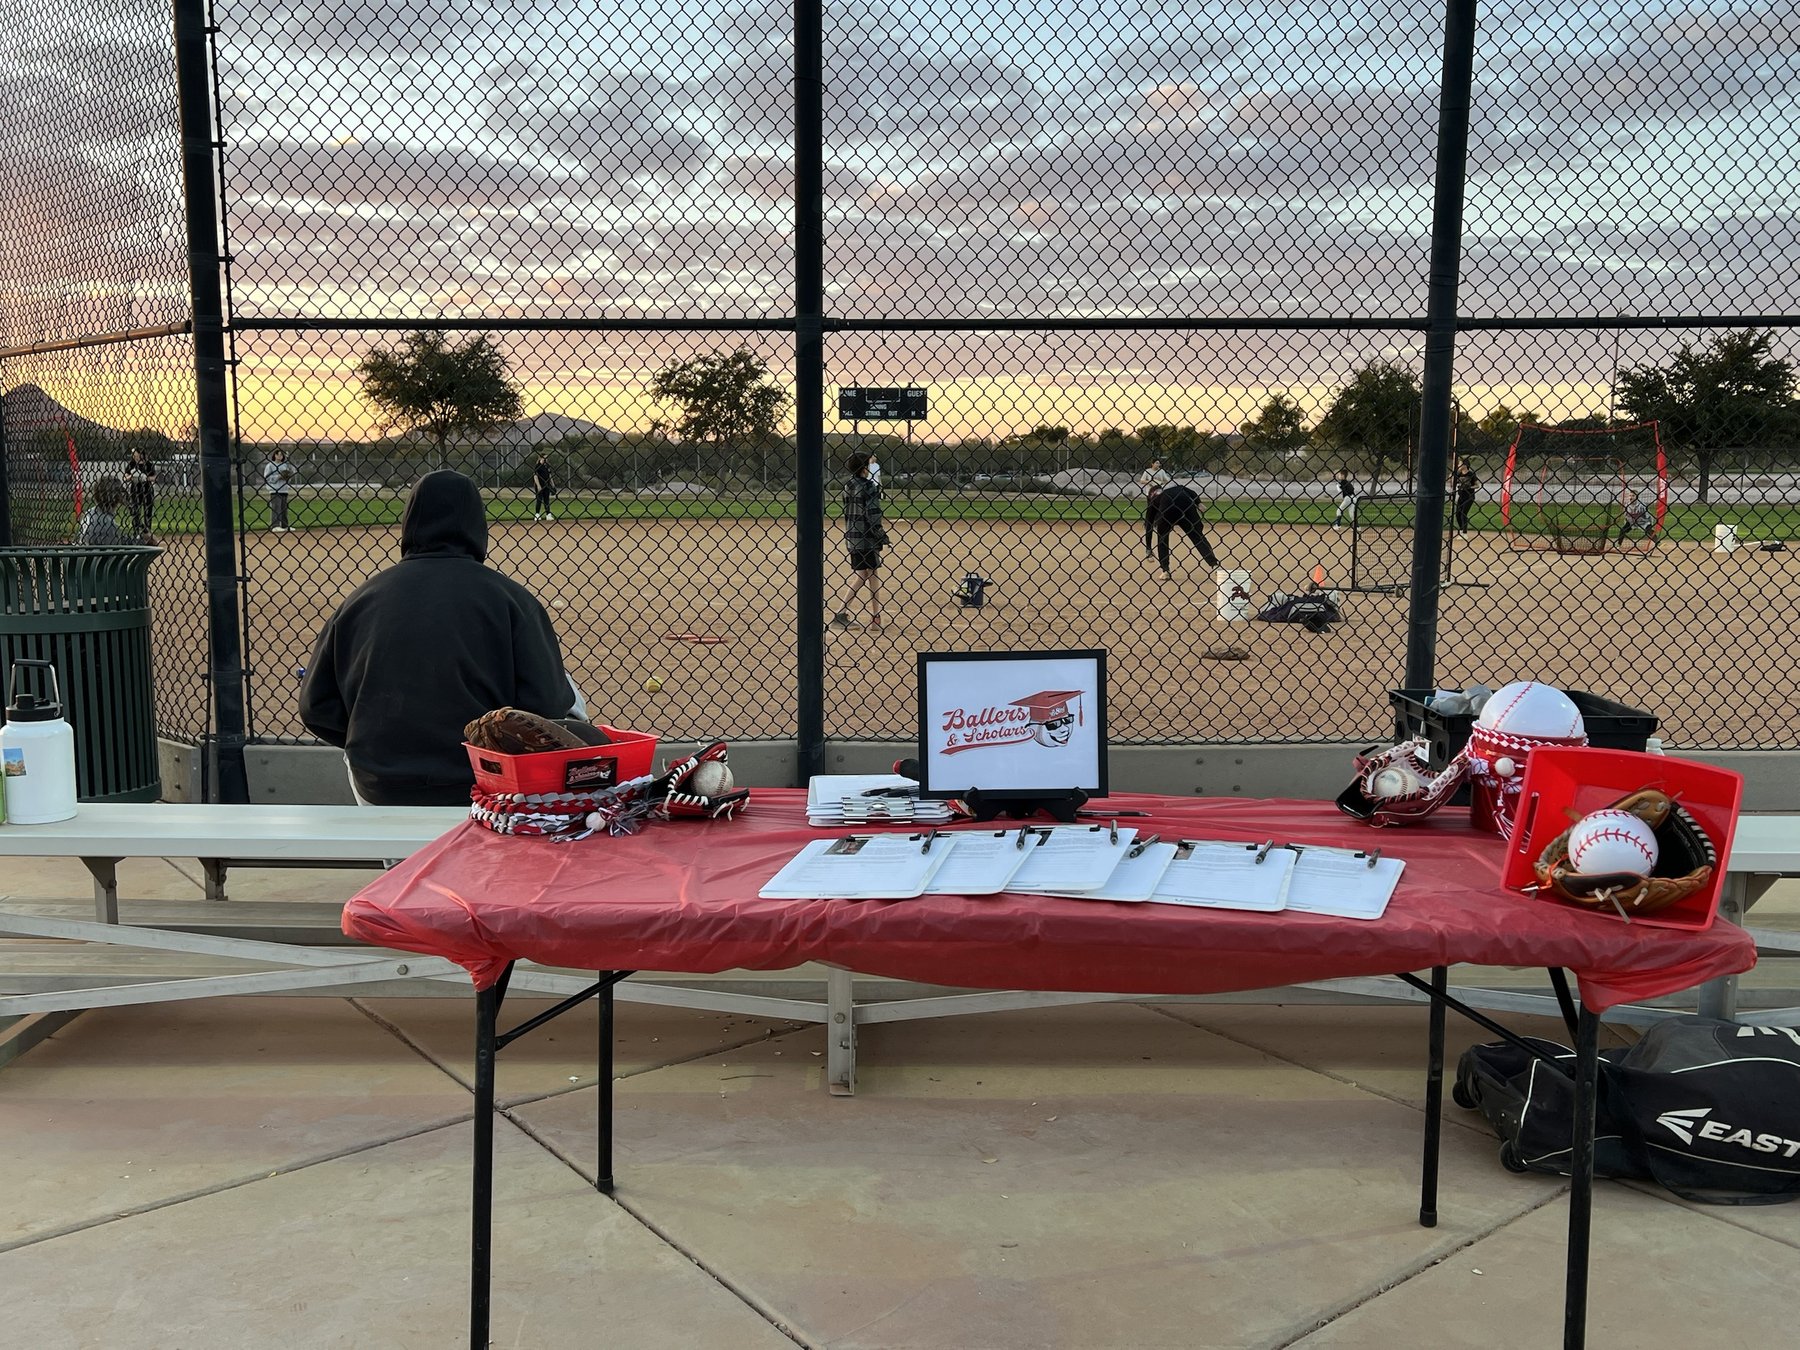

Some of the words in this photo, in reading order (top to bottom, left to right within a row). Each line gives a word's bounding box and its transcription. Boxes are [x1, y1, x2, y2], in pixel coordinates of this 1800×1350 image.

[943, 707, 1029, 731] Ballers
[946, 733, 958, 746] &
[963, 726, 1026, 742] Scholars
[1698, 1120, 1800, 1158] EAST
